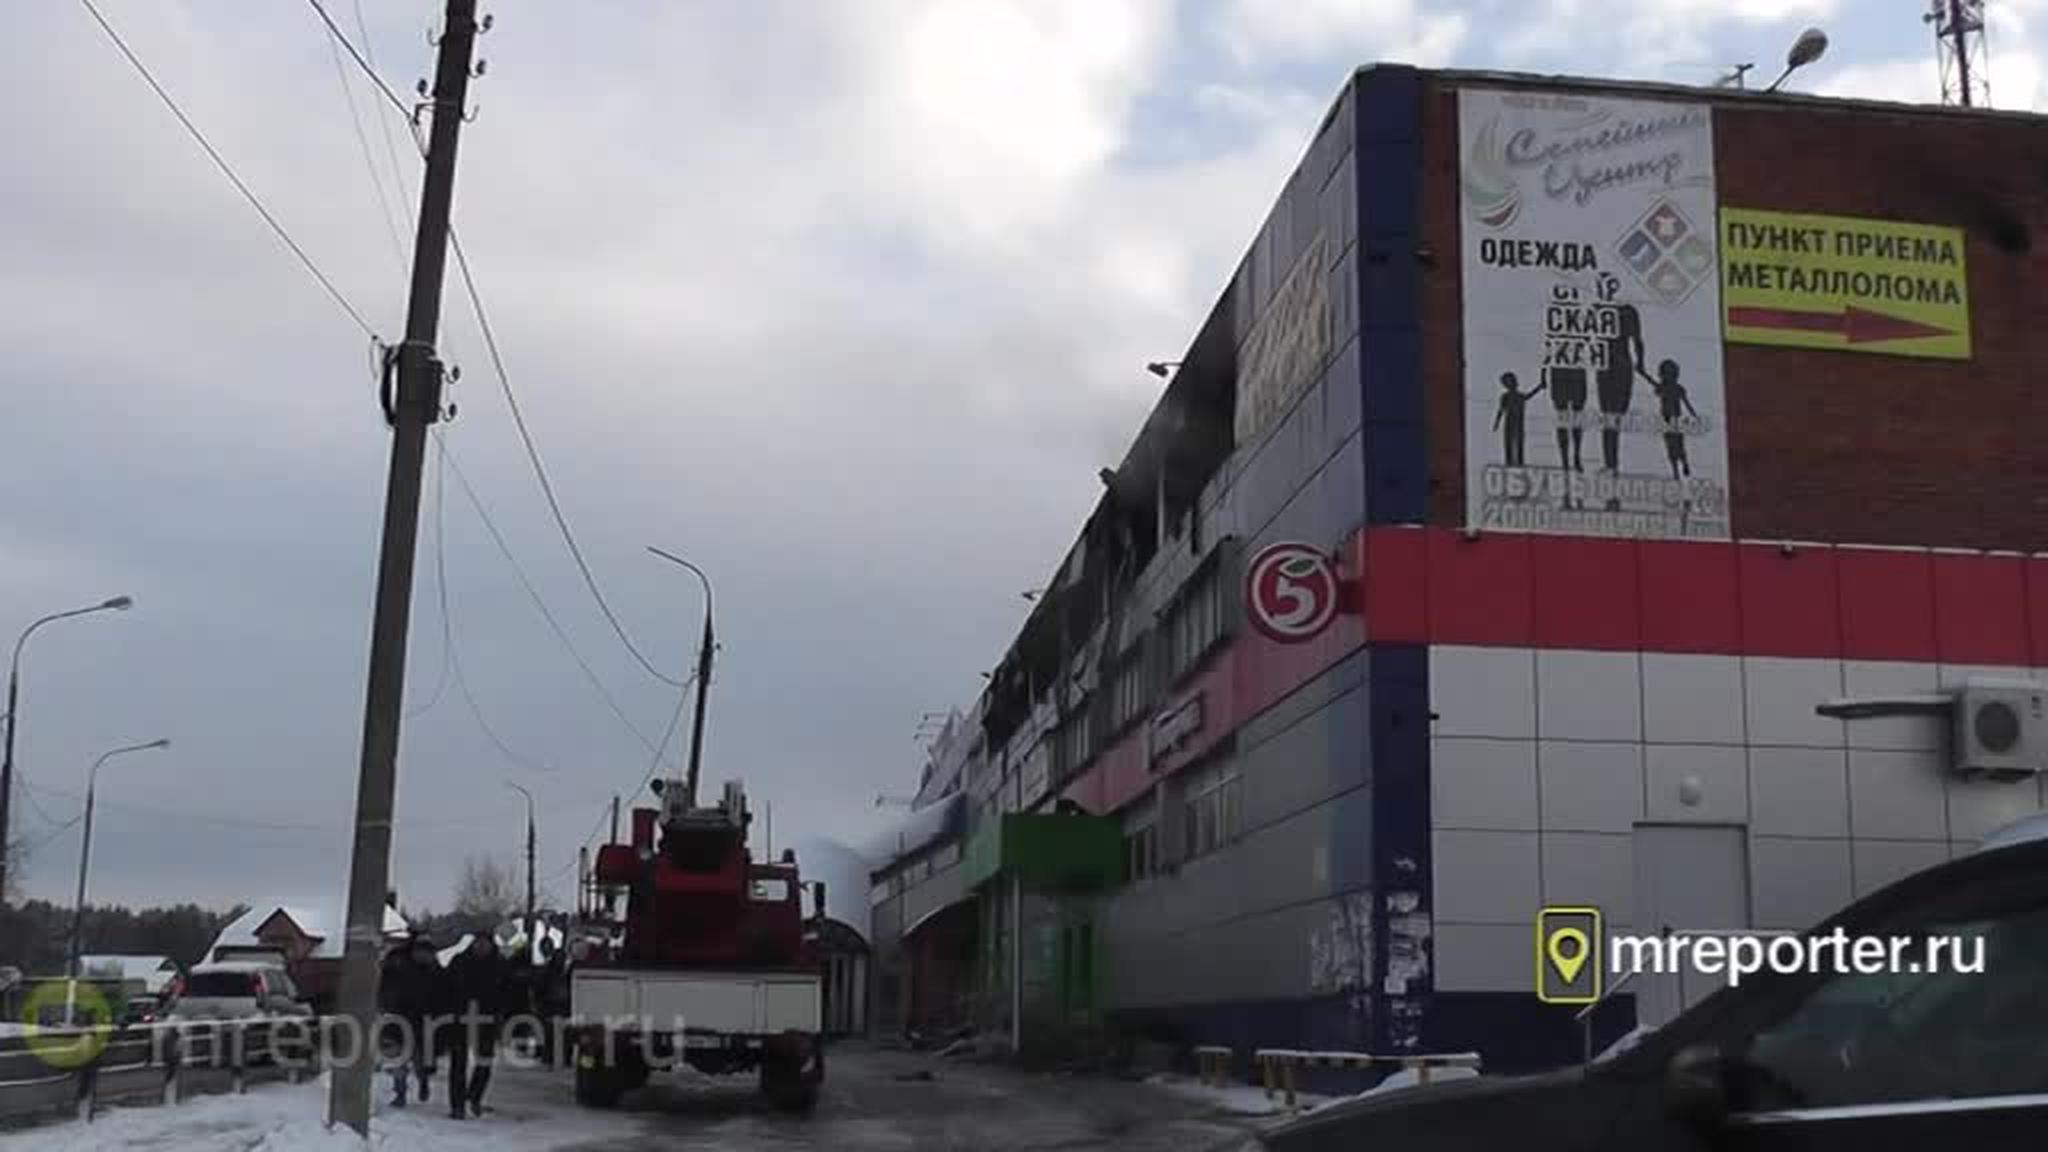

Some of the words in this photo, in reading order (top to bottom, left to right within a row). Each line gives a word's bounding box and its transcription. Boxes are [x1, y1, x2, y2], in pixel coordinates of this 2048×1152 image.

[1480, 238, 1598, 272] ОДЕЖДА
[1727, 222, 1827, 254] ПУНКТ
[1835, 231, 1958, 266] ПРИЕМА
[1727, 262, 1962, 305] МЕТАЛЛОЛОМА
[1547, 307, 1617, 335] СКАЯ
[1270, 557, 1322, 628] 5
